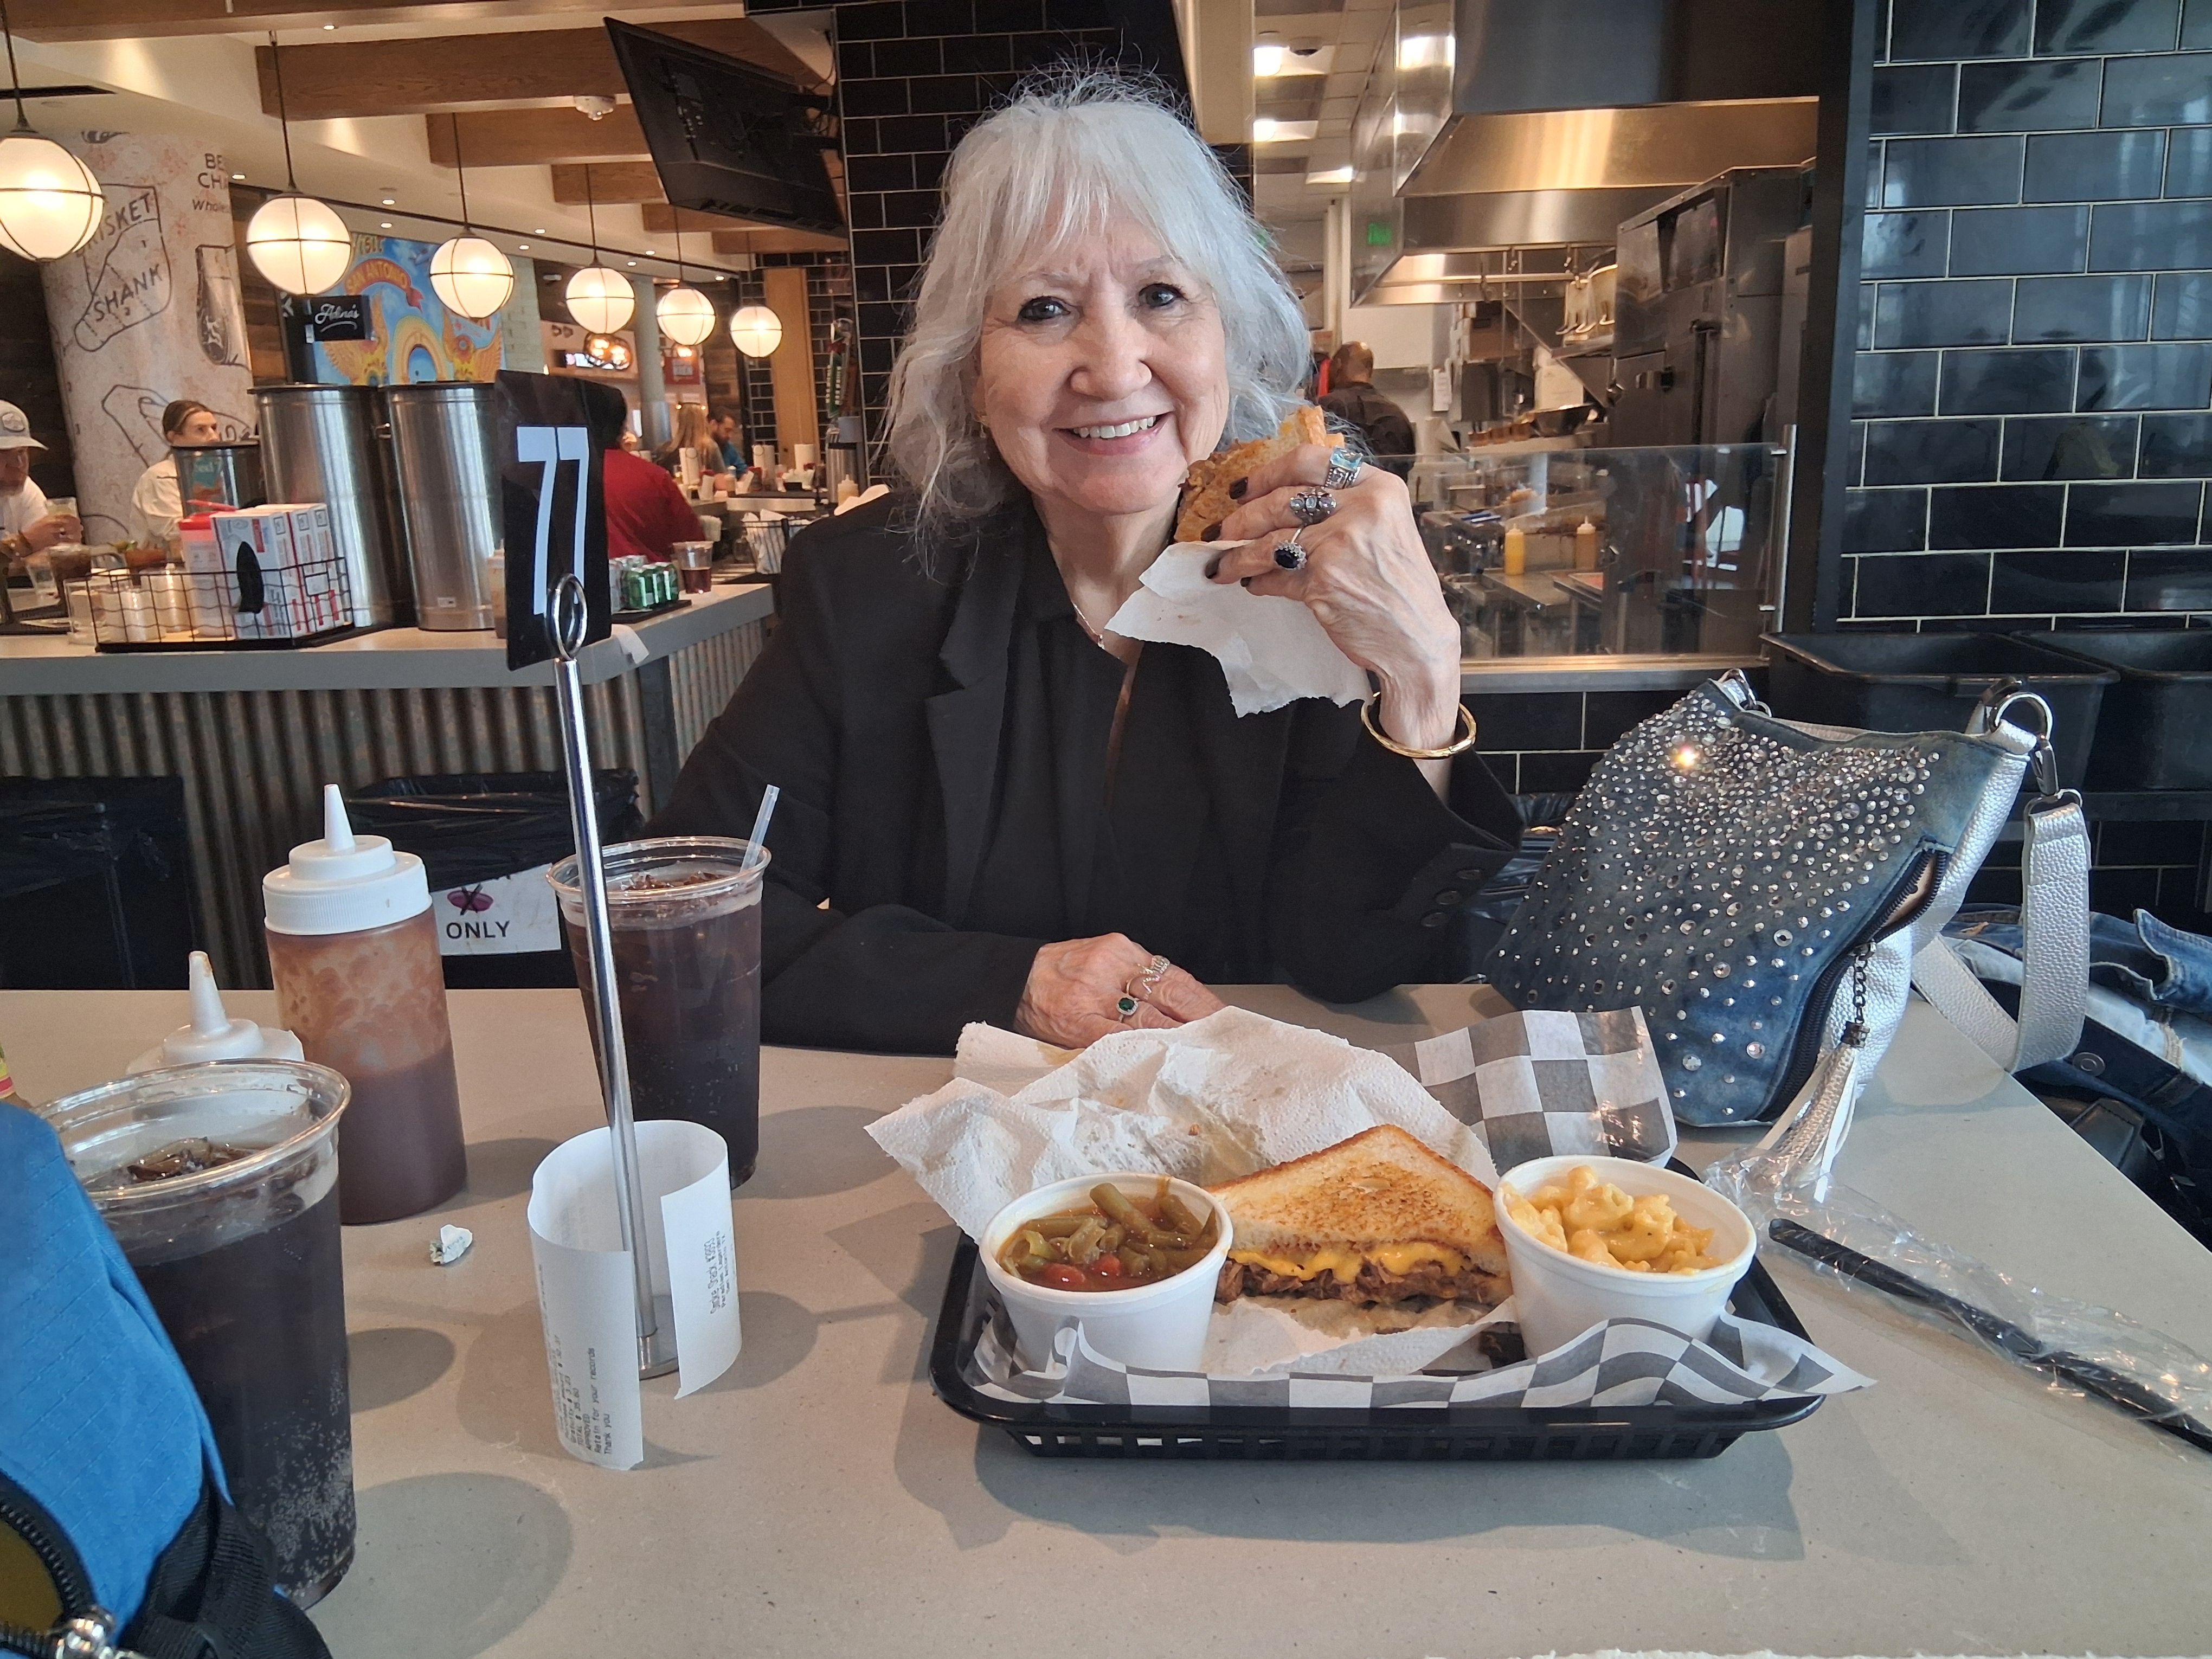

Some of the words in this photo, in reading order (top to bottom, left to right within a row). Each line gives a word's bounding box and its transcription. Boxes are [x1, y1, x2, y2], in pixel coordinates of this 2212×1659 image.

[78, 192, 150, 258] ISKET
[94, 263, 163, 321] SHANK
[516, 425, 590, 615] 77
[446, 920, 510, 939] ONLY
[706, 1263, 718, 1289] Shack
[710, 1288, 721, 1314] Smoke
[588, 1347, 596, 1380] records
[573, 1388, 581, 1411] 35.60
[591, 1384, 600, 1404] your
[568, 1409, 577, 1443] Gratuity
[583, 1414, 591, 1451] APPROVED
[593, 1425, 602, 1453] Retain
[603, 1432, 612, 1454] Thank
